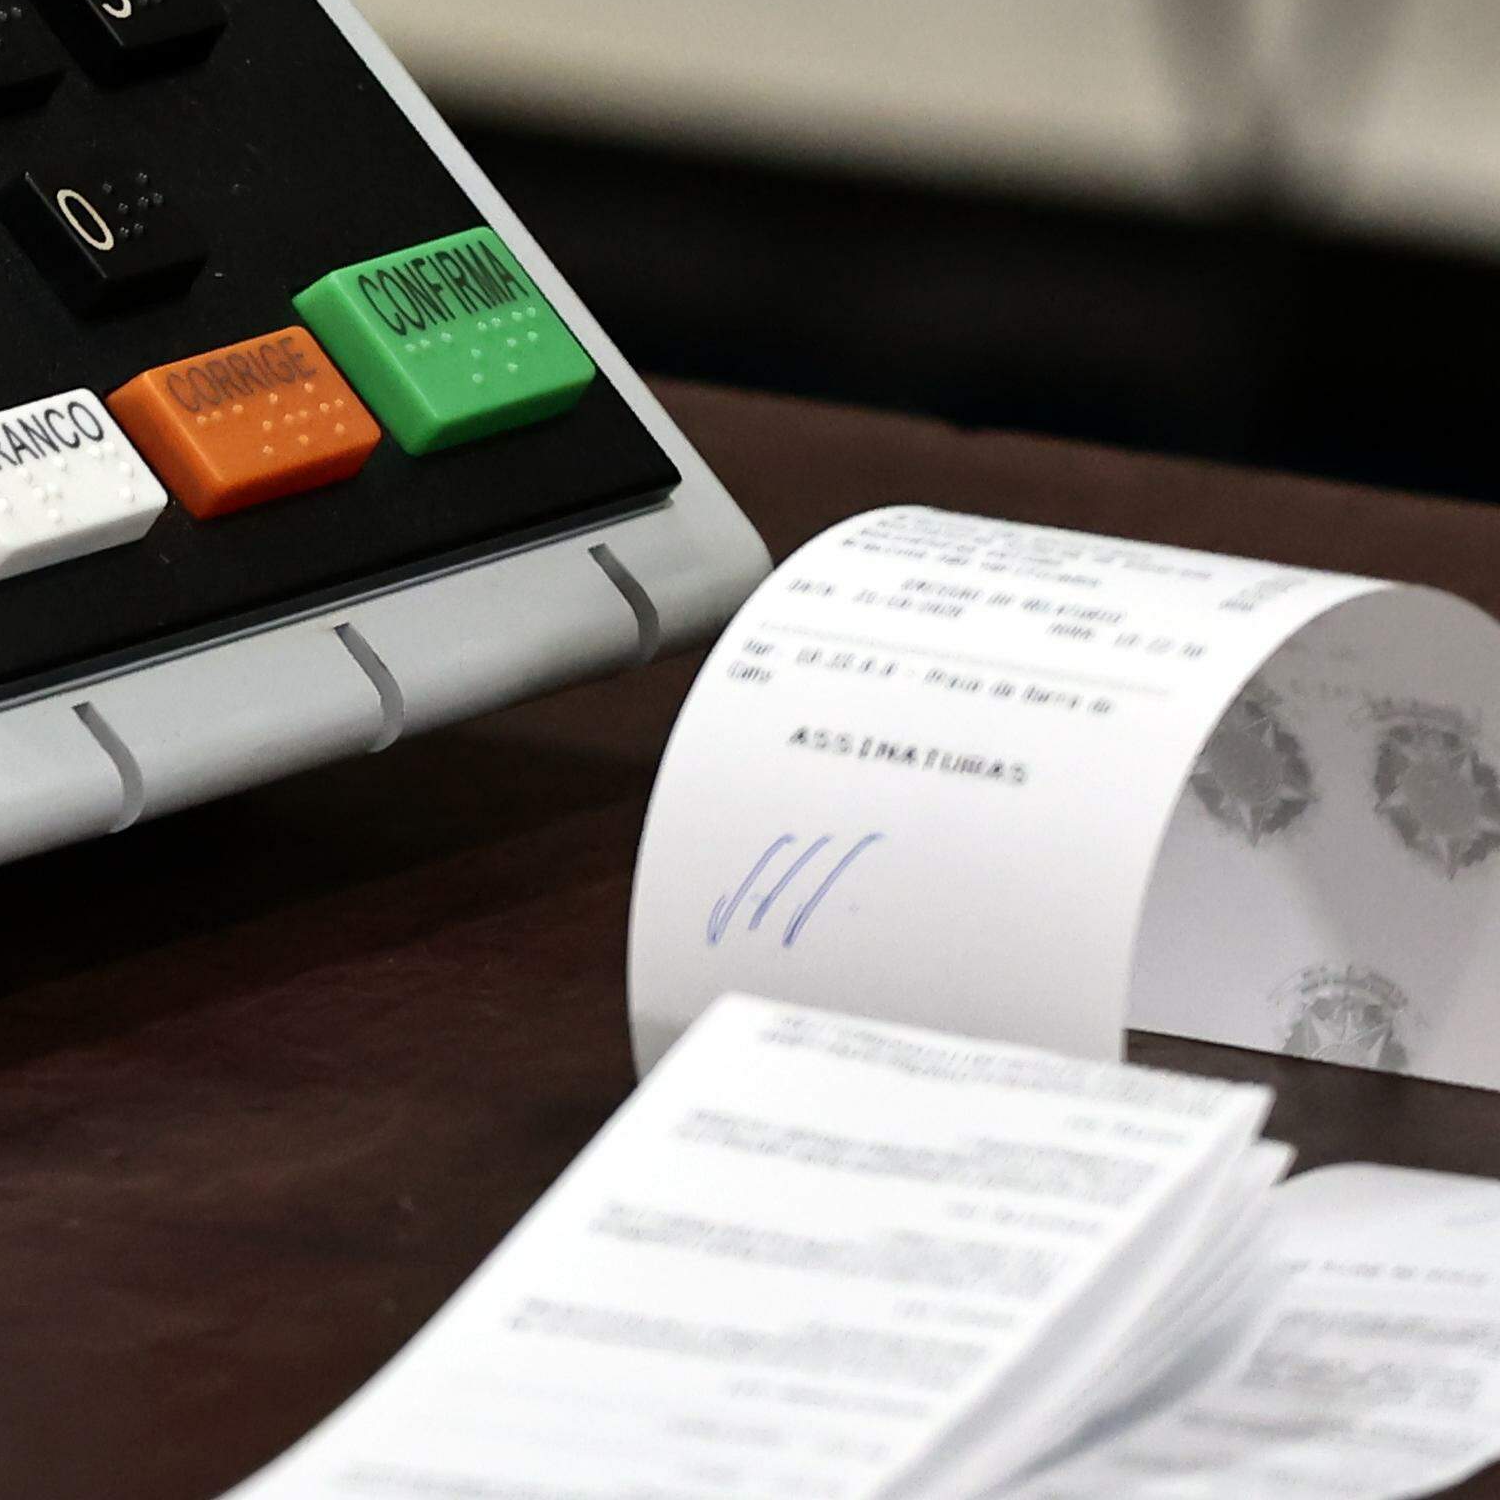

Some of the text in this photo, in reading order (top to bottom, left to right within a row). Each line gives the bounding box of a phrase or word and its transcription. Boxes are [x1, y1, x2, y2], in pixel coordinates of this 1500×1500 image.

[57, 190, 113, 250] 0
[357, 240, 531, 338] CONFIRMA
[165, 336, 317, 415] CORRIGE
[787, 725, 1030, 787] ASSINATURAS
